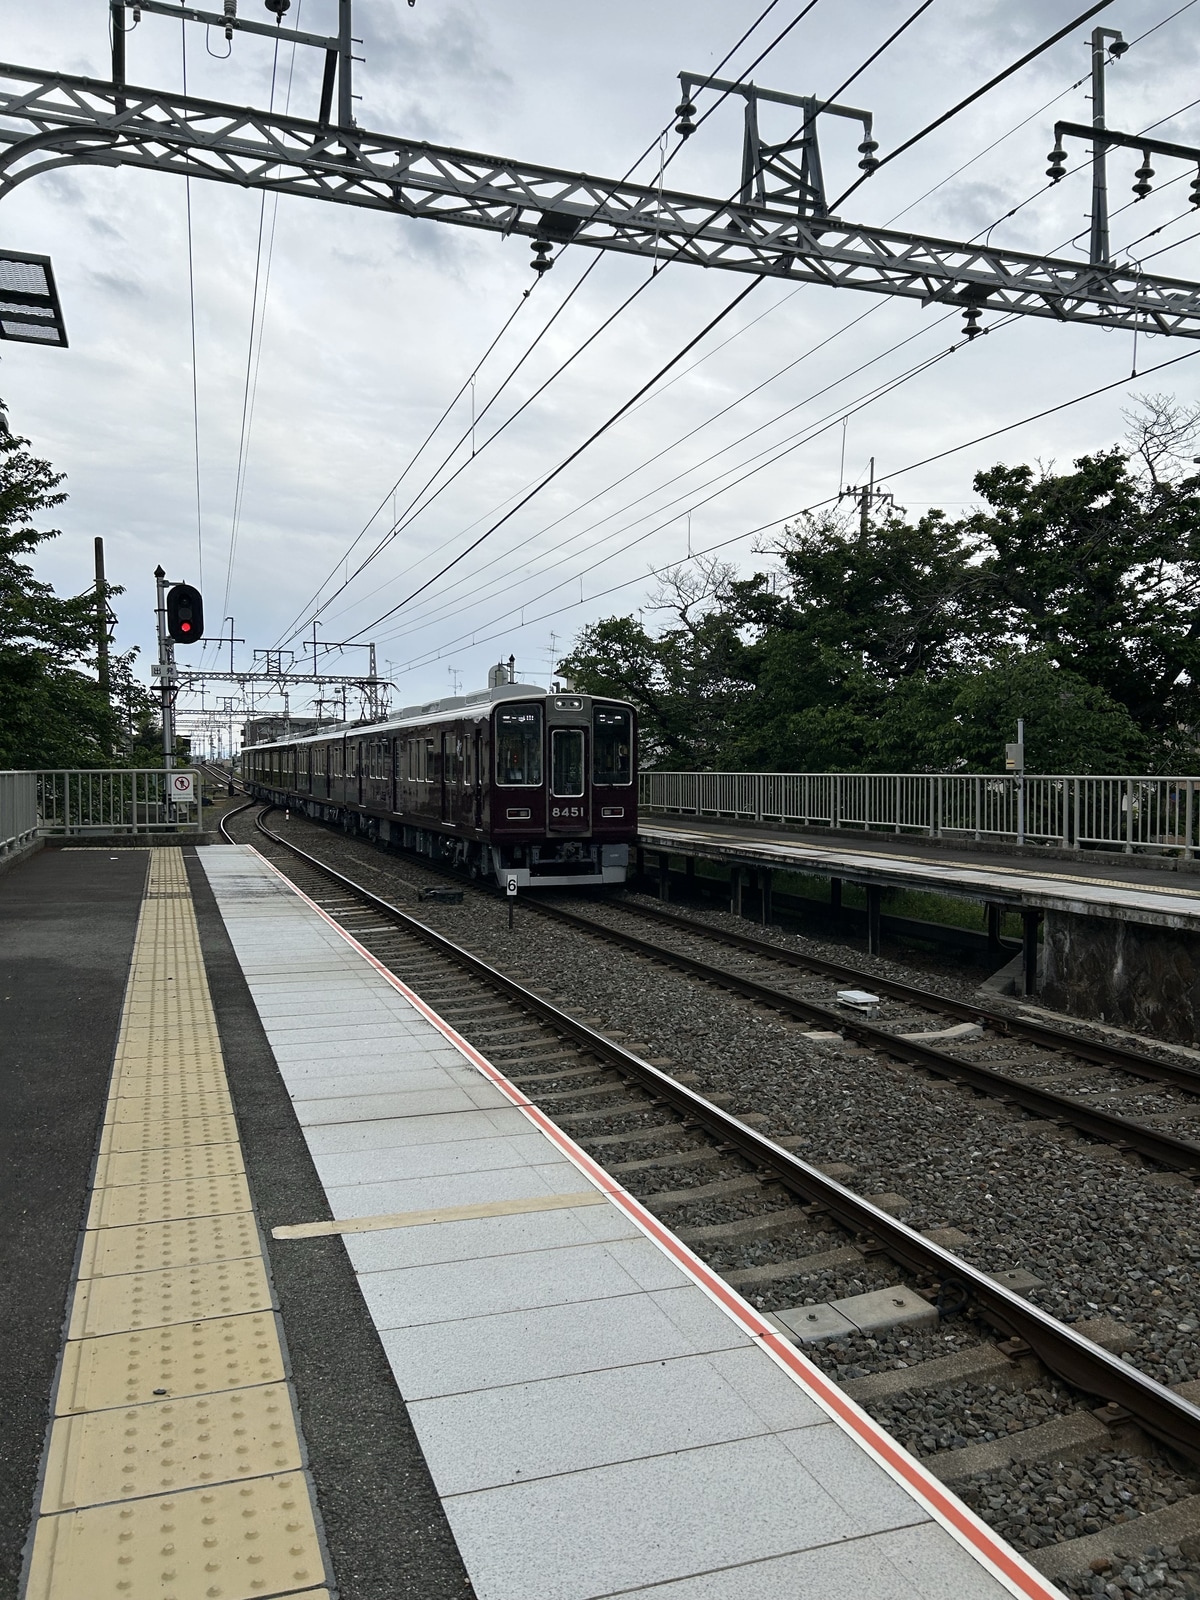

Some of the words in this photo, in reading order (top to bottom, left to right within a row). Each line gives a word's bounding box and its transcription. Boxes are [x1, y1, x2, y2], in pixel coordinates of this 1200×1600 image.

[153, 667, 174, 675] 出発
[552, 807, 584, 817] 8451
[508, 879, 516, 891] 6
